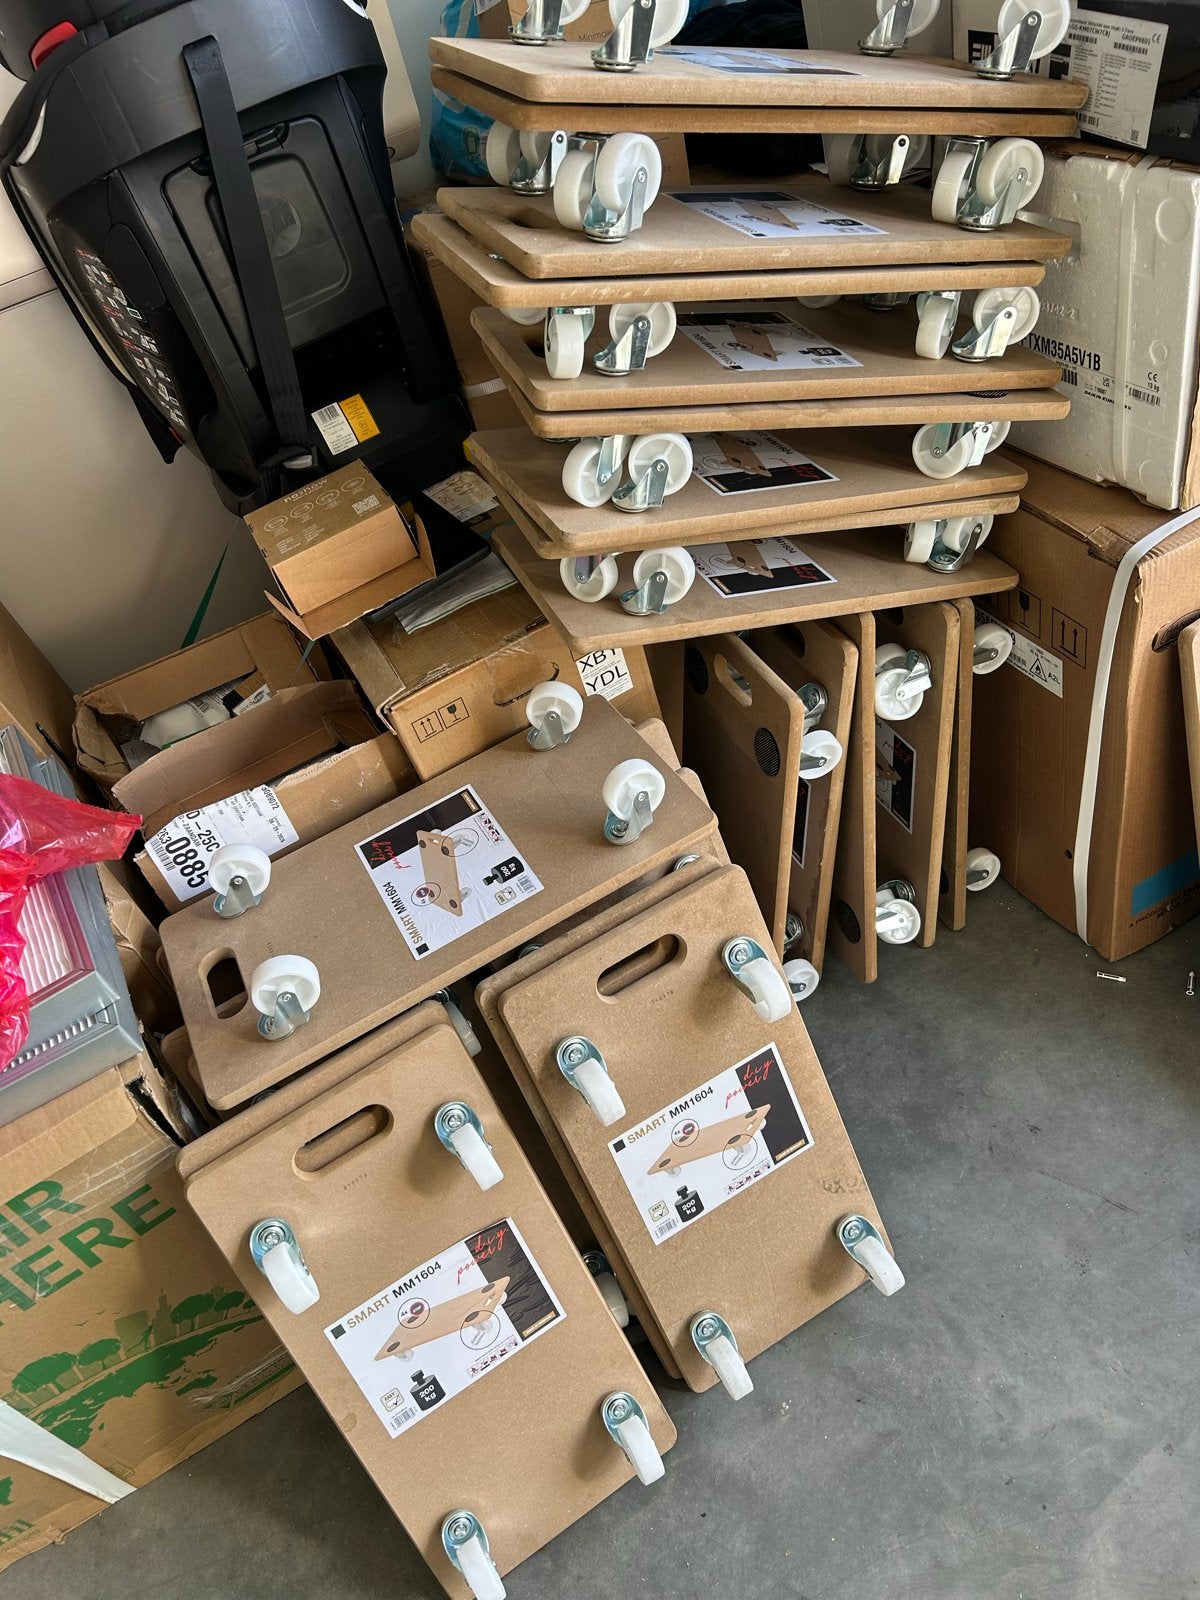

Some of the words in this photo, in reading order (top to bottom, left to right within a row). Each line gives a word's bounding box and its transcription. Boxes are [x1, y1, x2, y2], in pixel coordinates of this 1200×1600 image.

[585, 665, 628, 692] YDL
[1047, 672, 1061, 685] A2L
[182, 823, 201, 848] ZAANDAM
[198, 829, 221, 853] 25C
[164, 836, 209, 889] 0885
[500, 865, 511, 877] 200
[508, 862, 517, 873] kg
[382, 881, 407, 915] MM1604
[400, 915, 423, 945] SMART
[627, 1114, 667, 1145] SMART
[669, 1086, 714, 1119] MM1604
[681, 1199, 696, 1211] 200
[685, 1206, 697, 1215] kg
[346, 1294, 390, 1329] SMART
[391, 1261, 442, 1299] MM1604
[383, 1391, 396, 1401] EASY
[419, 1384, 435, 1398] 200
[424, 1391, 437, 1402] kg
